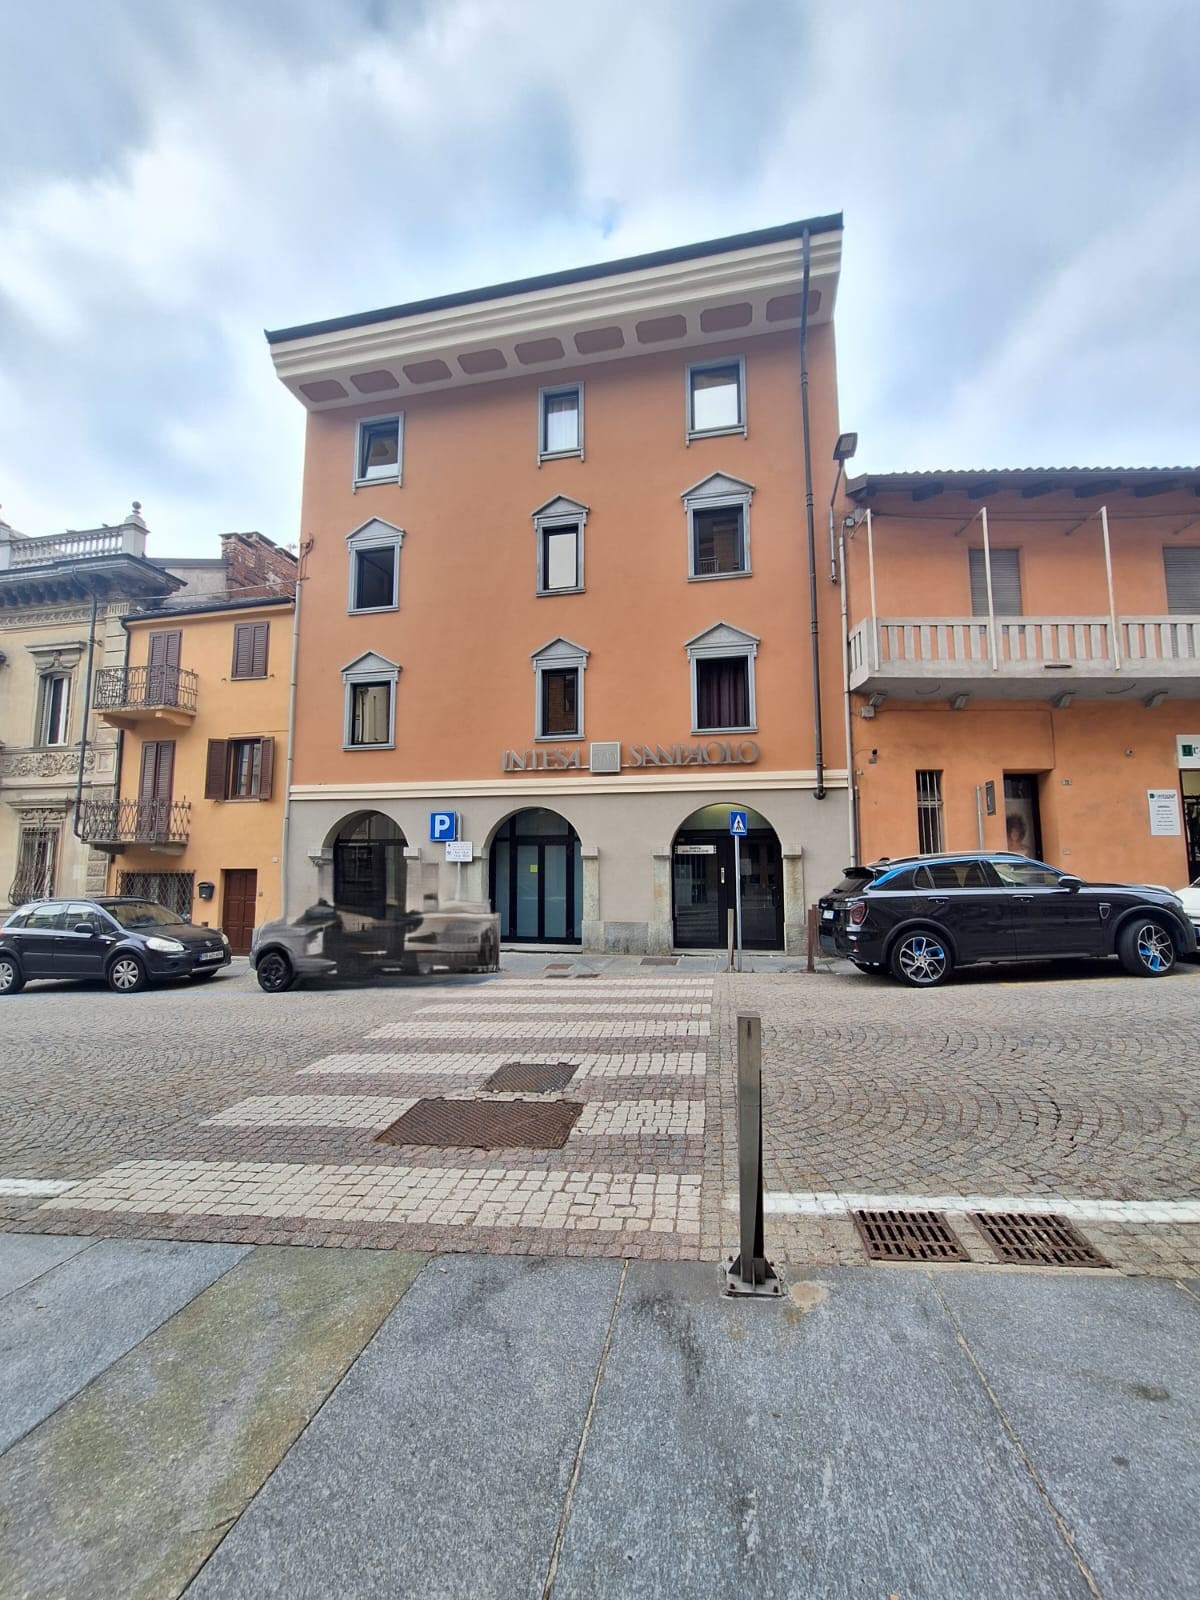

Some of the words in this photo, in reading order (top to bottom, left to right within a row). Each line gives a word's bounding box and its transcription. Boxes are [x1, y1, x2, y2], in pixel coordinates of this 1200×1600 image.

[502, 746, 581, 771] INTESA
[628, 740, 760, 767] SANPAOLO
[434, 814, 450, 838] P
